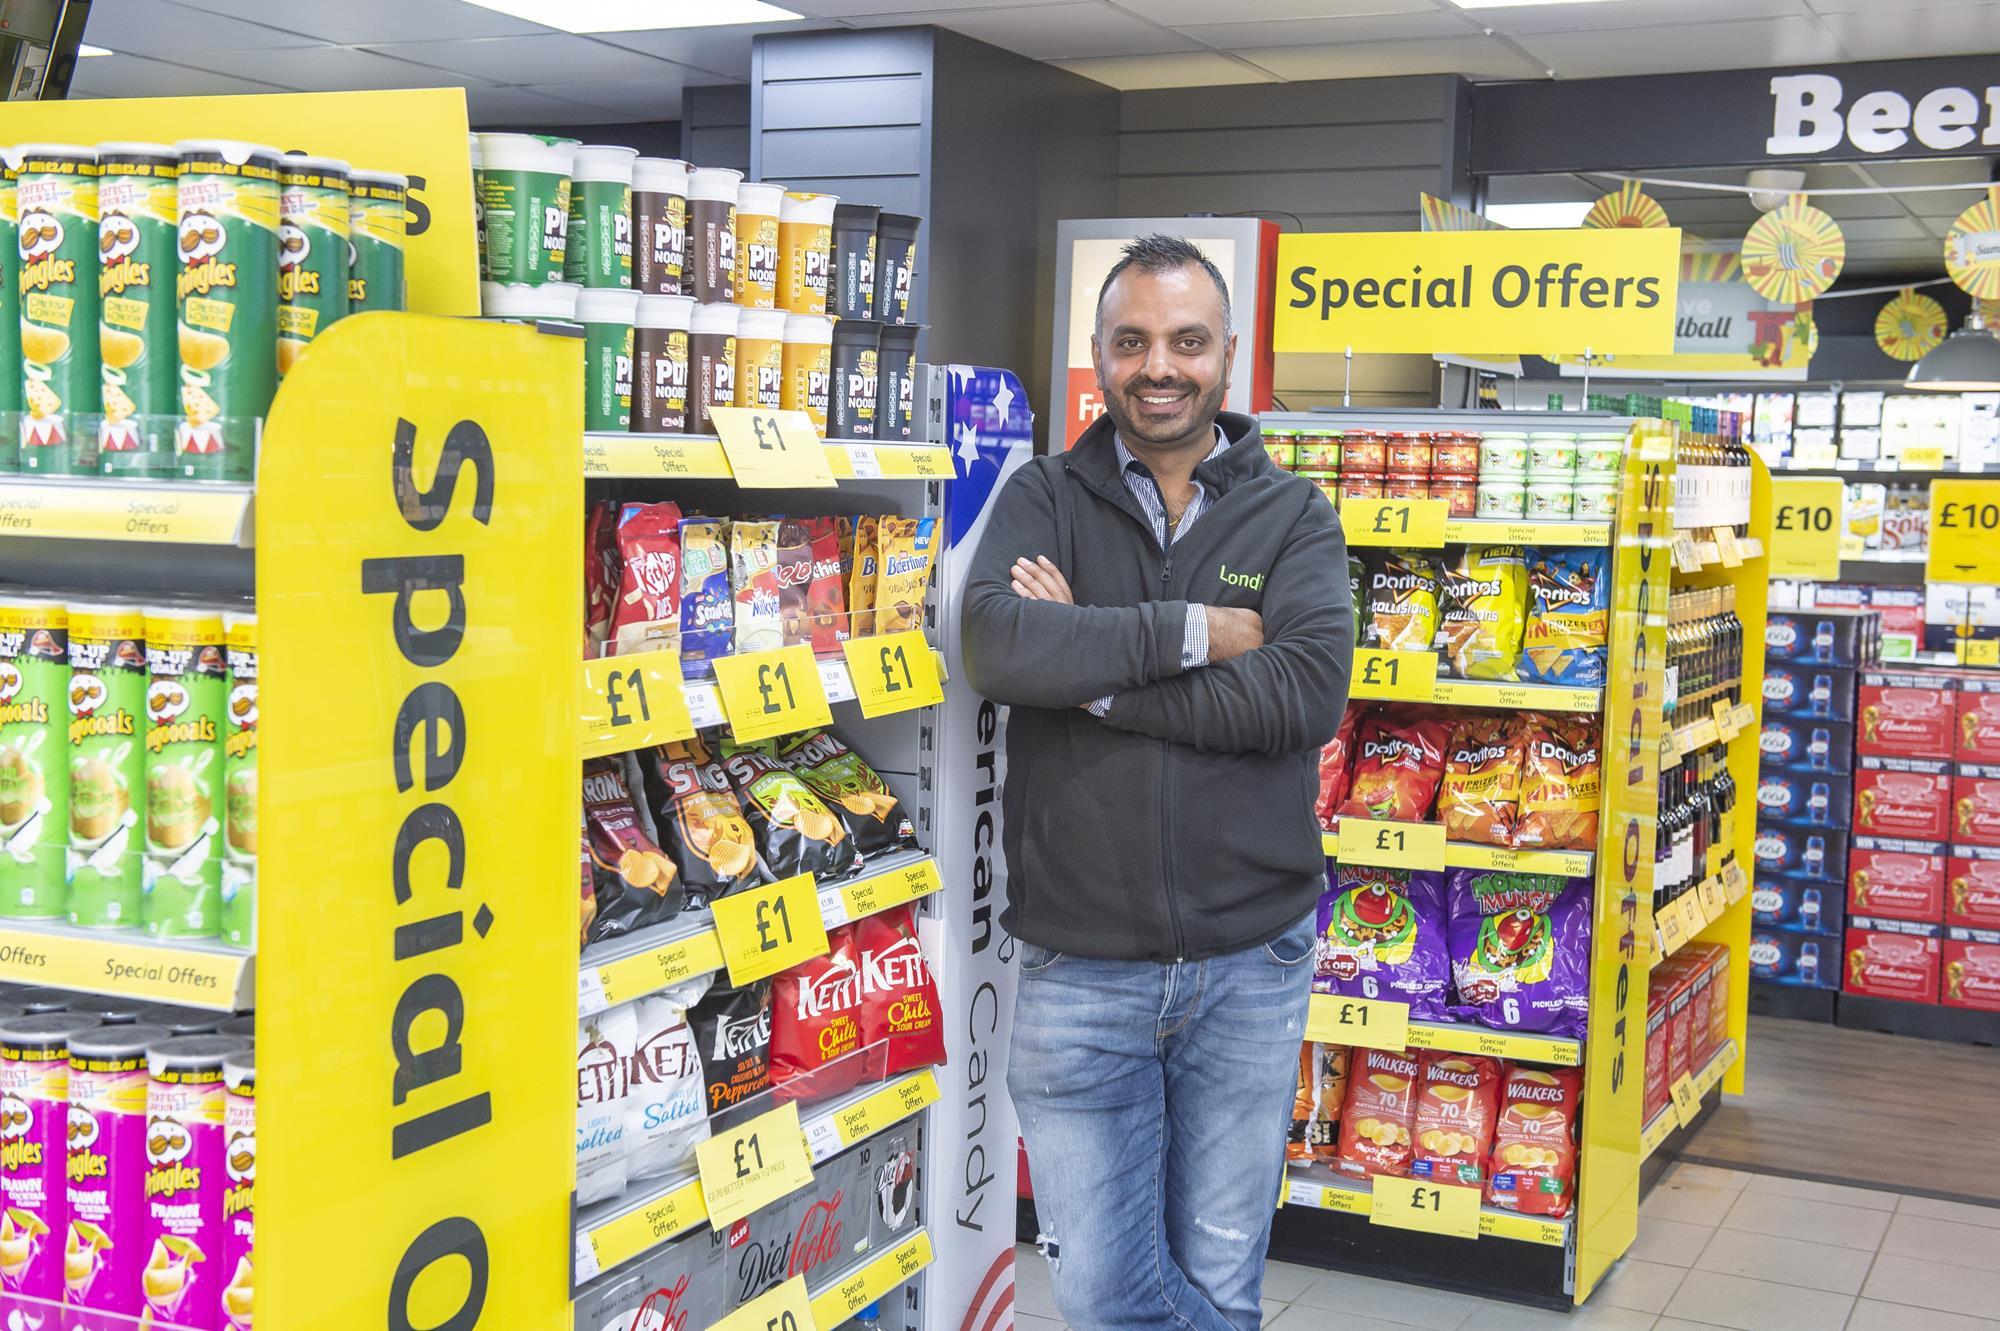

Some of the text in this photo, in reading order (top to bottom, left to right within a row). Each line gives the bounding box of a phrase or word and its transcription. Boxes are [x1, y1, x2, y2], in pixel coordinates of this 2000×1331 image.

[1289, 261, 1661, 321] Special Offers
[1675, 316, 1732, 338] tball
[752, 415, 788, 451] £1
[654, 446, 685, 459] Special
[911, 451, 933, 465] Special
[662, 460, 689, 473] Offers
[916, 465, 936, 475] Offers
[0, 498, 42, 512] pecial
[127, 500, 181, 515] Special
[1372, 506, 1410, 534] £1
[1775, 506, 1833, 531] £10
[1938, 502, 2000, 530] £10
[125, 518, 170, 534] Offers
[1507, 526, 1536, 536] Special
[1508, 534, 1533, 542] Offers
[1219, 564, 1265, 591] Londi
[1372, 573, 1436, 592] Doritos
[1528, 622, 1549, 639] IN
[880, 644, 914, 692] £1
[1362, 656, 1400, 686] £1
[606, 667, 651, 727] £1
[758, 661, 796, 715] £1
[1498, 688, 1527, 699] Special
[1499, 697, 1524, 705] Offers
[1455, 745, 1507, 765] Doritos
[1540, 741, 1597, 766] Doritos
[361, 415, 495, 1161] Special
[1465, 773, 1498, 788] PRIZES
[1376, 829, 1406, 851] £1
[1490, 851, 1519, 862] Special
[1491, 860, 1515, 869] Offers
[1564, 857, 1588, 868] Speci
[905, 868, 927, 883] Special
[1565, 865, 1587, 875] Offer
[852, 886, 874, 901] Special
[911, 883, 929, 895] Offers
[1470, 872, 1569, 897] MONSTER
[857, 900, 877, 913] Offers
[755, 894, 793, 953] £1
[657, 947, 687, 966] Special
[1611, 817, 1640, 1095] Offers
[104, 958, 218, 988] Special Offers
[664, 962, 690, 980] Offers
[956, 698, 1001, 1233] erican Candy
[1332, 961, 1355, 971] OFF
[1362, 976, 1379, 999] 6
[903, 992, 923, 1004] SWEET
[1339, 1003, 1369, 1026] £1
[1503, 998, 1521, 1025] 6
[830, 1015, 849, 1029] SWEET
[888, 1019, 932, 1033] & SOUR CREAM
[1408, 1027, 1434, 1038] Special
[1408, 1036, 1431, 1046] Offers
[1479, 1037, 1507, 1047] Special
[1480, 1046, 1503, 1054] Offers
[1552, 1045, 1577, 1055] Specia
[1367, 1052, 1420, 1077] WALKERS
[1426, 1065, 1480, 1087] WALKERS
[897, 1080, 921, 1101] Special
[1379, 1091, 1397, 1108] 70
[1507, 1083, 1565, 1102] WALKERS
[643, 1090, 700, 1130] Salted
[904, 1092, 924, 1111] Offers
[1440, 1103, 1460, 1118] 70
[843, 1106, 867, 1128] Special
[849, 1122, 870, 1138] Offers
[1521, 1119, 1541, 1134] 70
[733, 1132, 764, 1179] £1
[859, 1148, 871, 1166] 10
[1328, 1191, 1355, 1203] Special
[1329, 1200, 1352, 1211] Offers
[1410, 1187, 1441, 1213] £1
[645, 1202, 676, 1224] Special
[653, 1217, 679, 1239] Offers
[1540, 1225, 1565, 1237] Speci
[739, 1189, 845, 1303] Diet Coke
[1541, 1233, 1562, 1245] Offer
[895, 1244, 917, 1264] Special
[901, 1260, 919, 1276] Offers
[841, 1278, 866, 1299] Special
[847, 1294, 868, 1311] Offers
